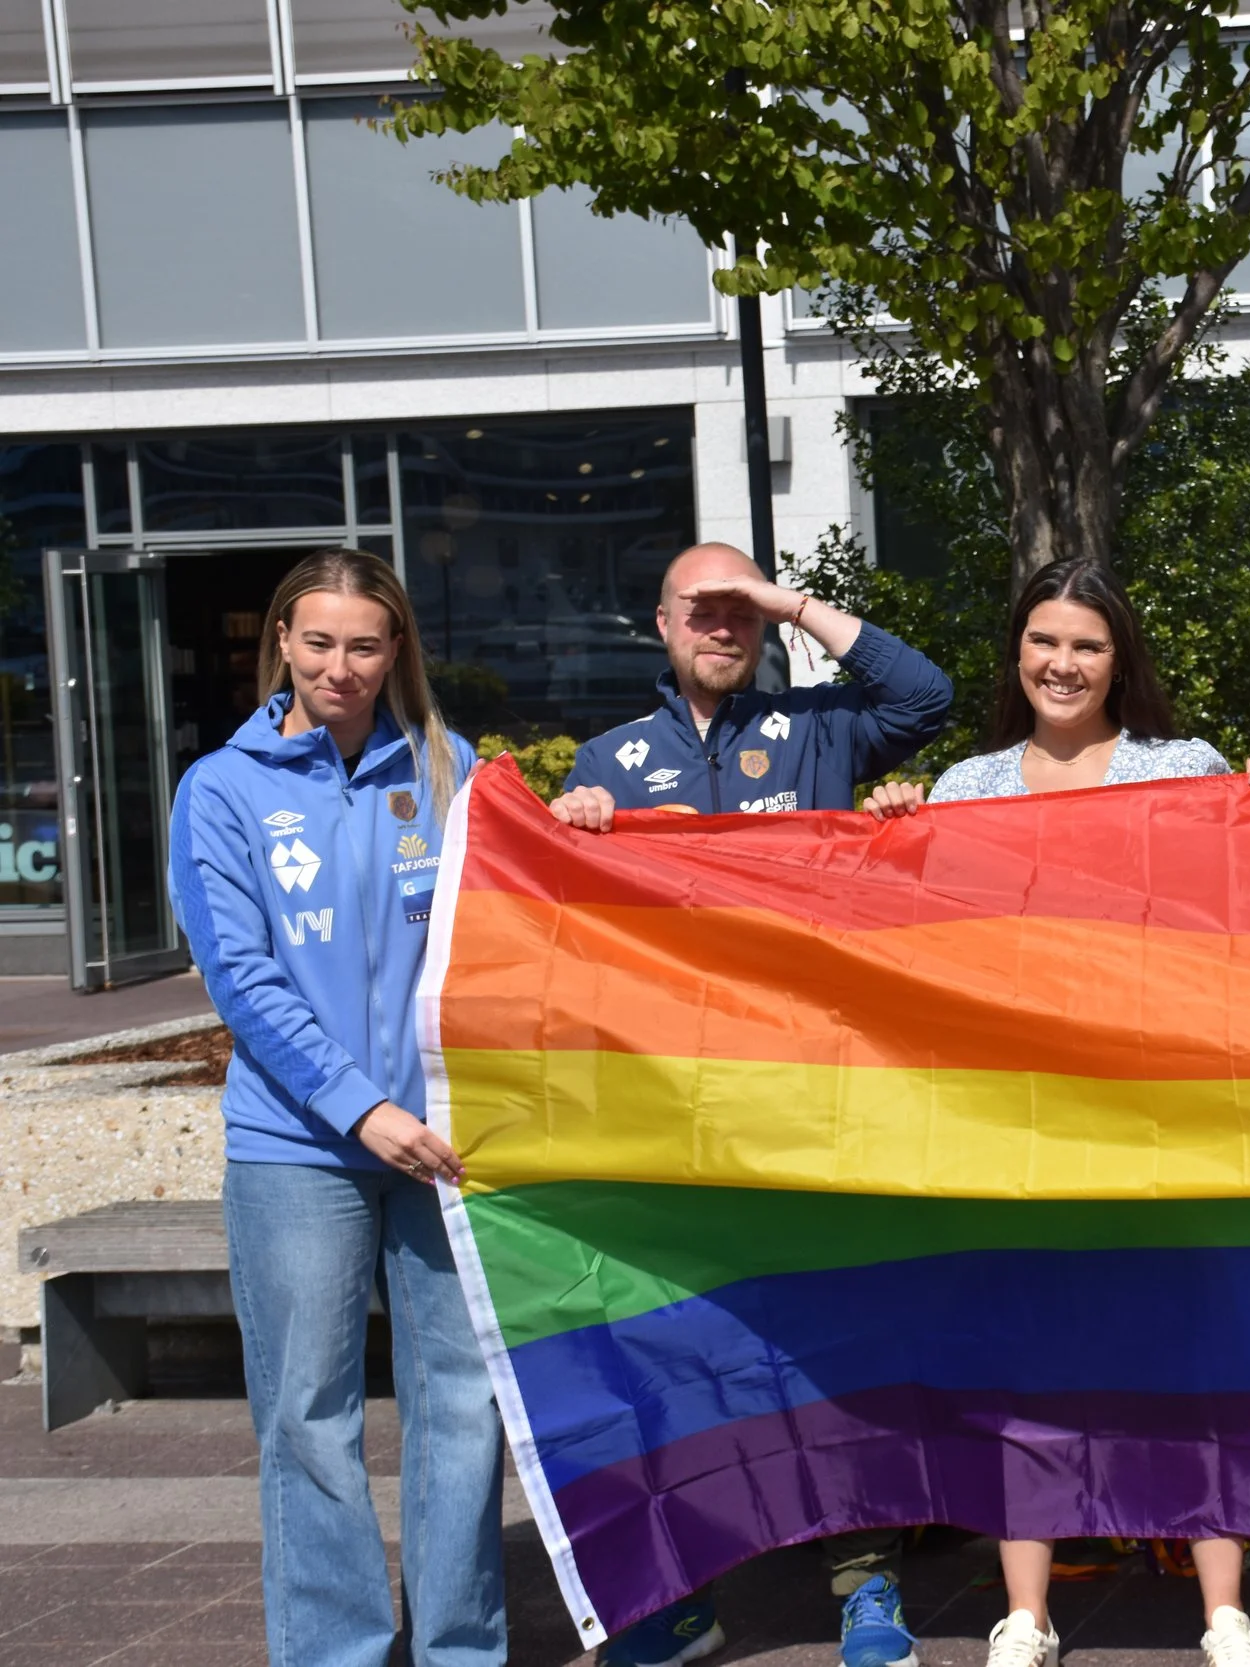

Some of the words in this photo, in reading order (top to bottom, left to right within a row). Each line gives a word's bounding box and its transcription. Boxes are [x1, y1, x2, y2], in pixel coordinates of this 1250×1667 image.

[648, 780, 679, 793] umbro
[764, 791, 797, 808] INTER
[269, 826, 304, 838] umbro
[391, 856, 441, 874] TAFJORD
